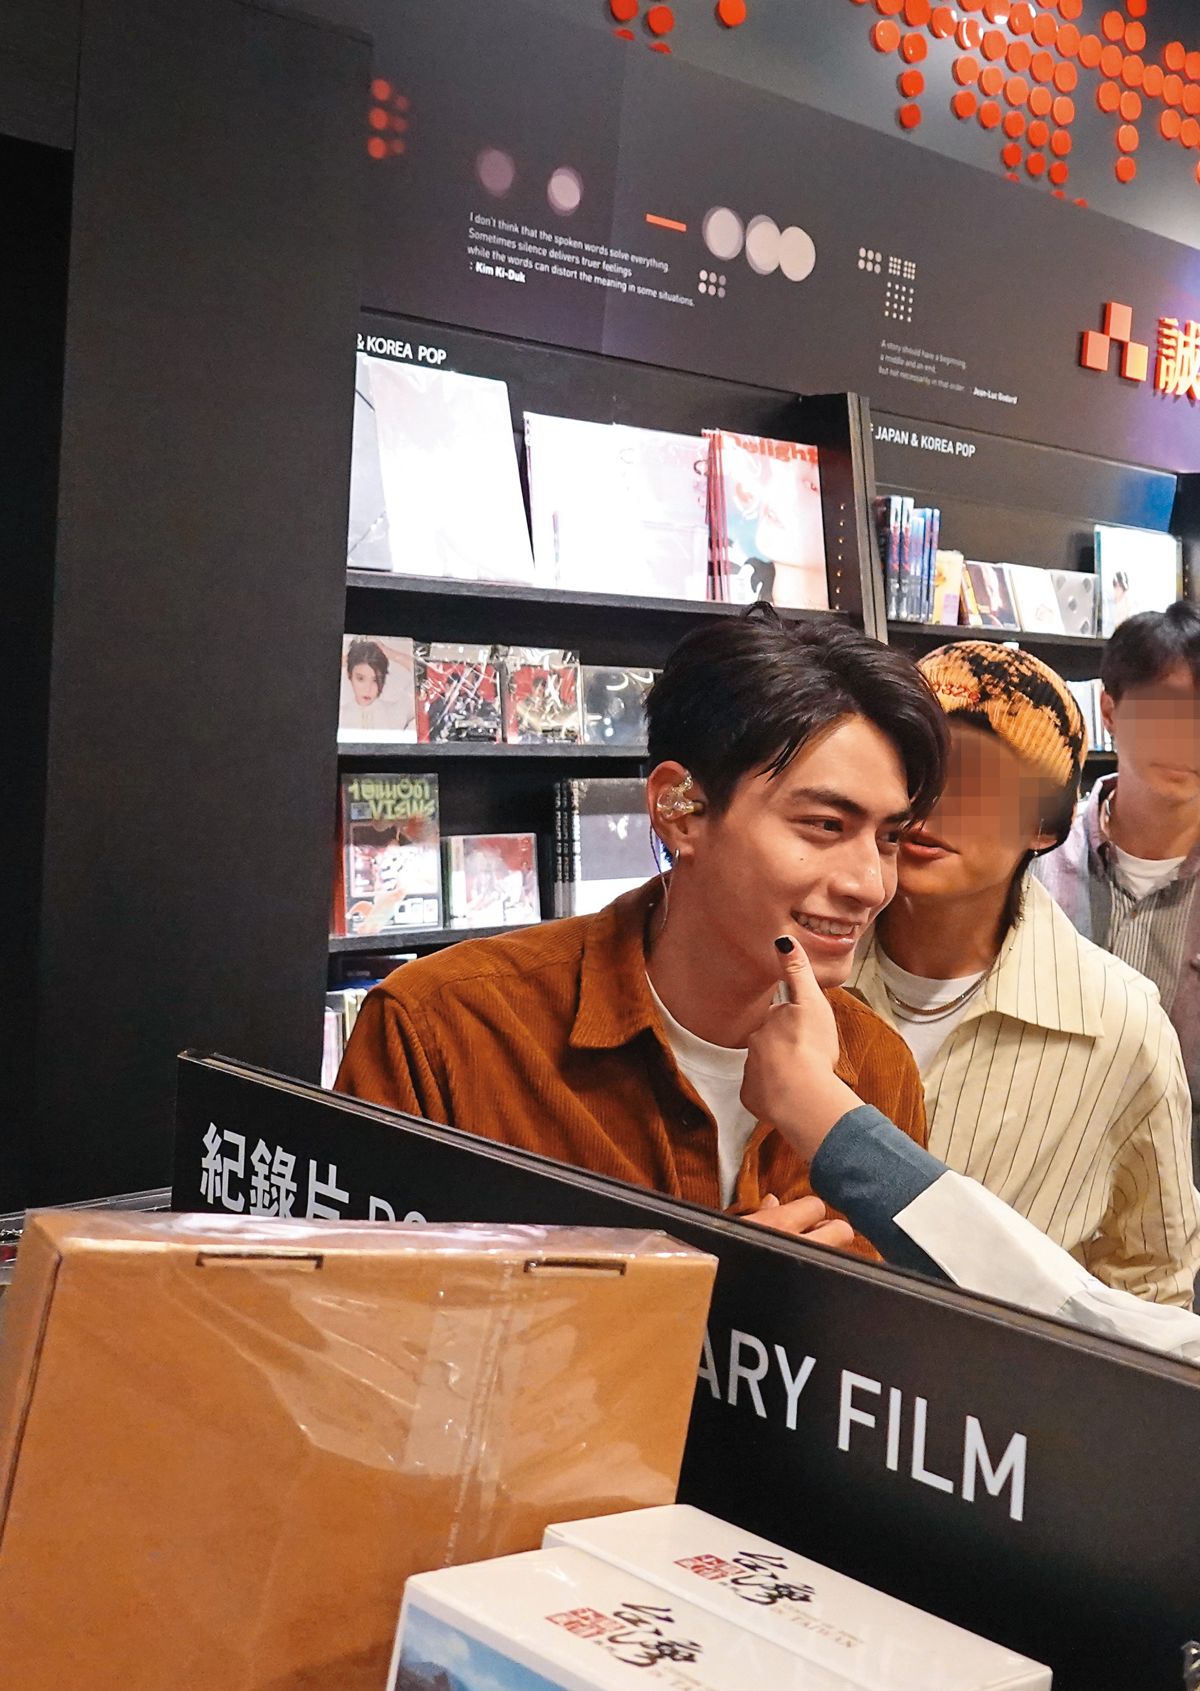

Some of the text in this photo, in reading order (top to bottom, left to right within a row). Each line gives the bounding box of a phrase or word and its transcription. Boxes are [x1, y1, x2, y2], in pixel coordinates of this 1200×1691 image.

[468, 228, 632, 278] Sometimes silence delivers truer feelings
[470, 212, 669, 273] I don't think that the spoken words solve everything
[468, 245, 490, 258] while
[492, 250, 506, 262] the
[506, 256, 533, 268] words
[534, 262, 550, 272] can
[551, 264, 578, 279] distort
[579, 271, 592, 282] the
[594, 275, 627, 292] meaning
[628, 282, 636, 292] in
[636, 286, 657, 298] some
[476, 262, 494, 276] Kim
[495, 266, 526, 283] Ki-Duk
[366, 336, 413, 360] KOREA
[418, 345, 446, 364] POP
[875, 426, 976, 458] JAPAN & KOREA POP
[200, 1122, 349, 1220] 紀錄片
[838, 1368, 1027, 1522] FILM
